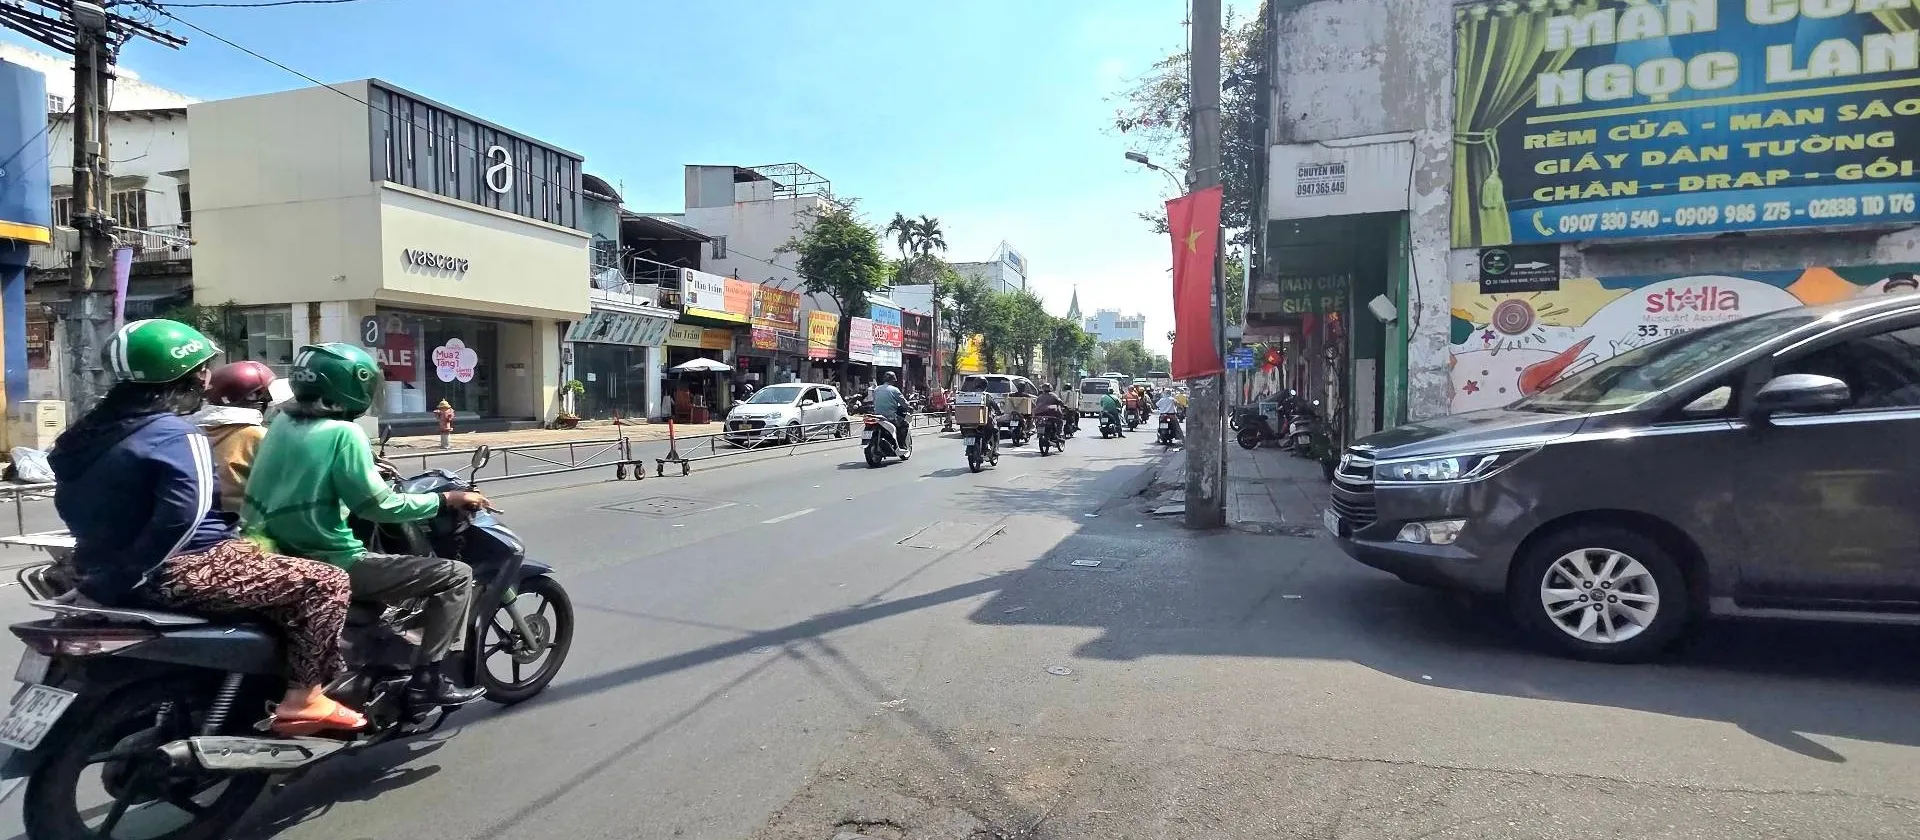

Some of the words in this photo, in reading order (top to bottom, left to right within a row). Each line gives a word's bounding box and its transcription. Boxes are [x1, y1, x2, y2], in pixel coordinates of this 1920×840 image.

[1536, 52, 1738, 108] NGỌC
[1766, 29, 1919, 84] LAN
[1523, 129, 1597, 150] RÈM
[1608, 119, 1689, 141] CỬA
[1729, 108, 1825, 131] MÀN
[1837, 99, 1920, 121] SÁO
[1742, 131, 1895, 158] TƯỜNG
[1532, 180, 1638, 202] CHĂN
[1679, 169, 1790, 191] DRAP
[1559, 213, 1597, 233] 0907
[1630, 209, 1660, 228] 540
[1675, 206, 1719, 226] 0909
[1762, 201, 1792, 221] 275
[403, 247, 470, 275] vascara
[170, 340, 204, 359] Grab
[376, 349, 412, 366] ALE
[436, 350, 454, 359] Mua
[454, 351, 460, 360] 2
